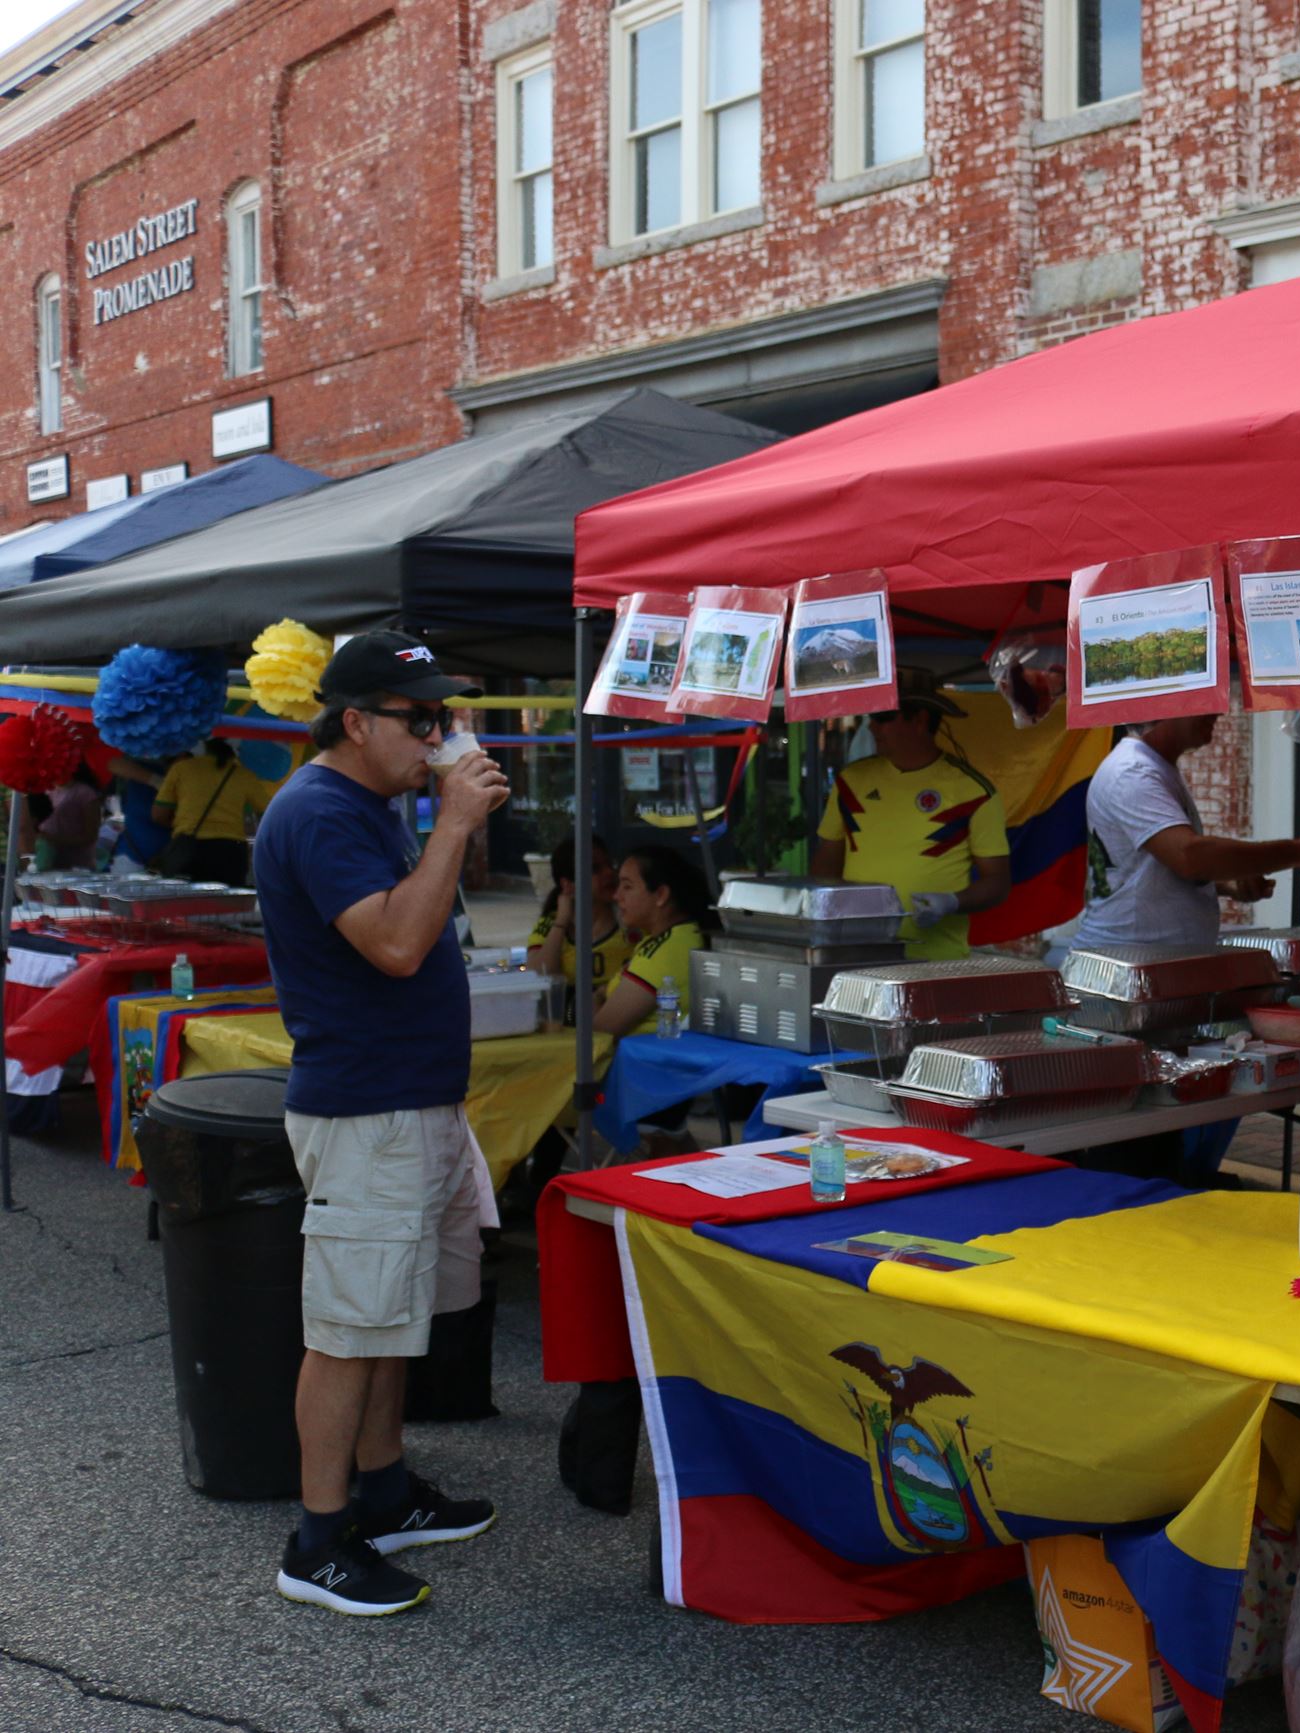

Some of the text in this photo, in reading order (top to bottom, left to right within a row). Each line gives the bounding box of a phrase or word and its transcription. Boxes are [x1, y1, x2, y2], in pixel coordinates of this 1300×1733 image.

[85, 198, 198, 279] SALEM STREET
[94, 256, 194, 325] PROMENADE
[1270, 582, 1284, 592] Las
[1112, 613, 1119, 622] El
[1120, 611, 1144, 621] Oriente
[1062, 1588, 1105, 1608] amazon
